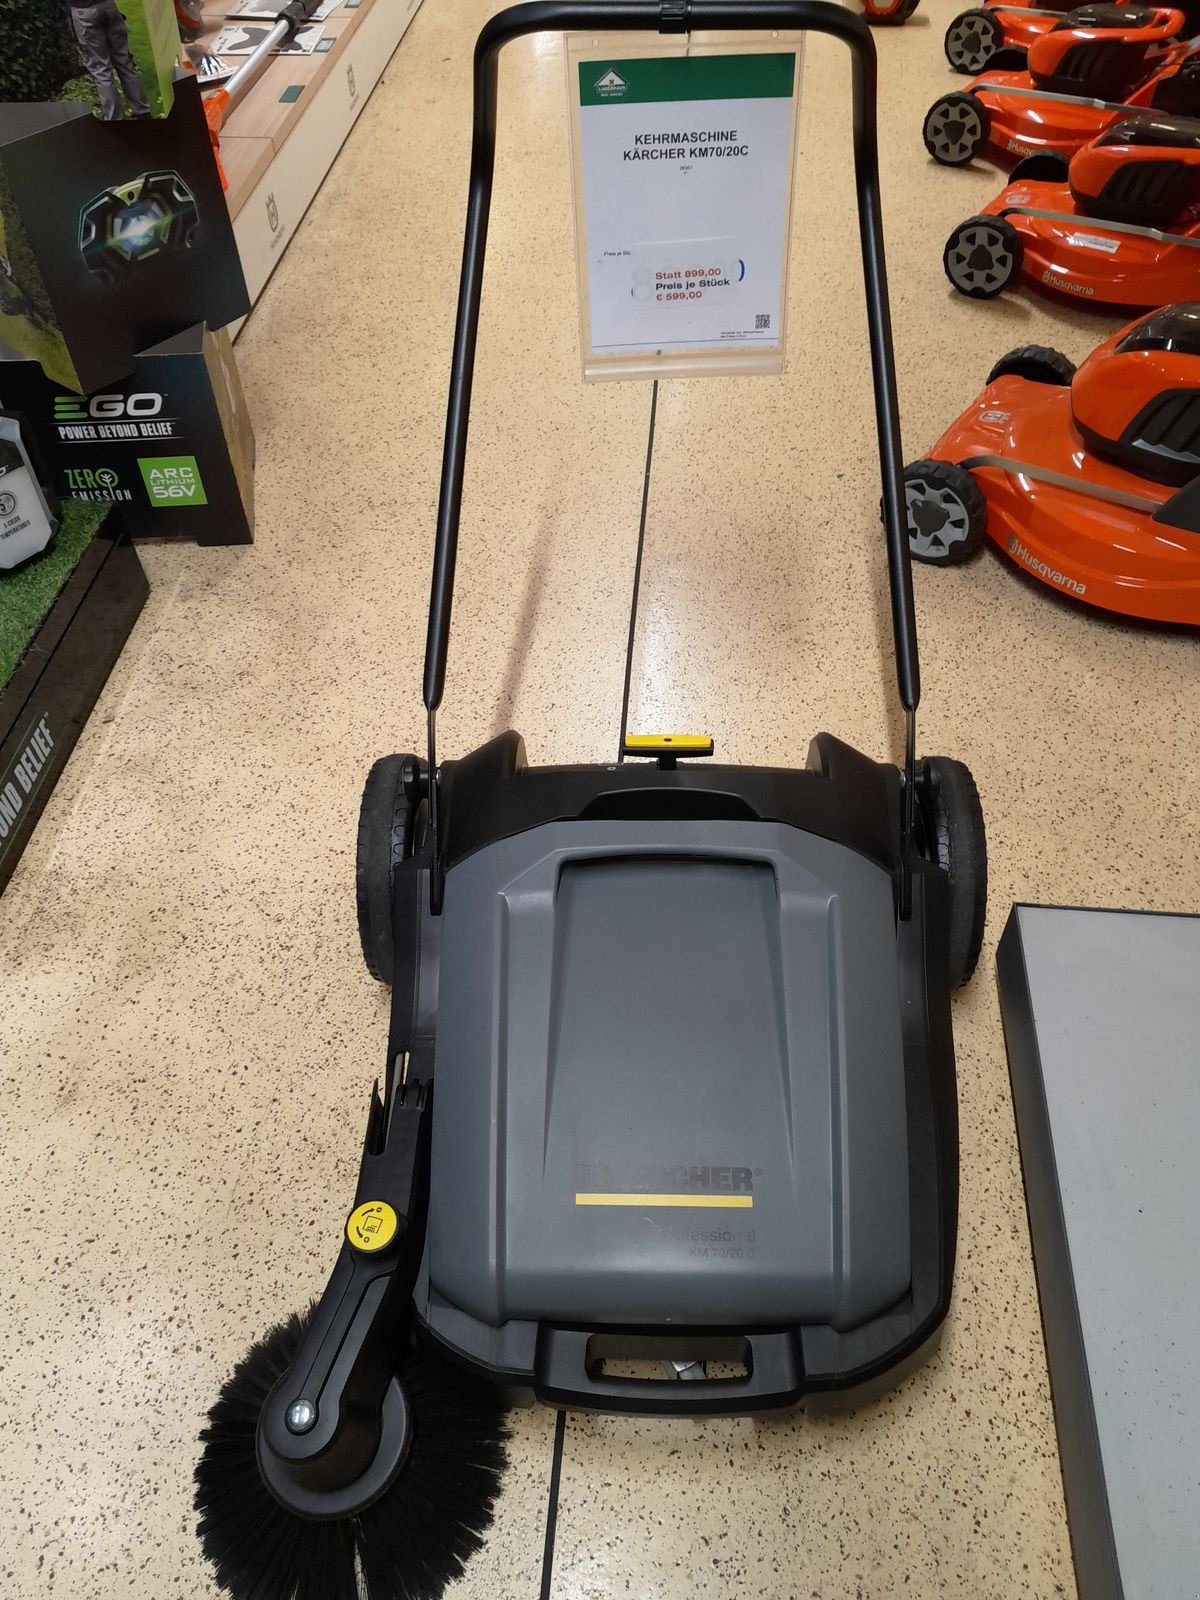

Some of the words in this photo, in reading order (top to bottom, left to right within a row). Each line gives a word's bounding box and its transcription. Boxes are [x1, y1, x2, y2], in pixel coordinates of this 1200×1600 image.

[635, 130, 738, 145] KEHRMASCHINE
[623, 147, 686, 161] KÄRCHER
[689, 145, 749, 158] KM70/20C
[655, 271, 682, 280] Statt
[685, 268, 721, 278] 899,00
[655, 282, 683, 291] Preis
[686, 281, 696, 290] je
[699, 278, 731, 288] Stück
[1050, 272, 1094, 296] Husqvarna
[656, 293, 663, 301] €
[666, 290, 703, 301] 599,00
[54, 393, 163, 419] EGO
[58, 425, 98, 440] POWER
[98, 424, 139, 439] BEYOND
[140, 422, 173, 437] BELIEF
[64, 468, 119, 489] ZERO
[150, 467, 193, 479] ARC
[150, 478, 195, 486] LITHIUM
[72, 489, 132, 501] EMISSION
[153, 484, 196, 498] 56V
[1017, 543, 1087, 595] Husqvarna
[0, 782, 23, 839] OND
[14, 718, 54, 795] BELIEF
